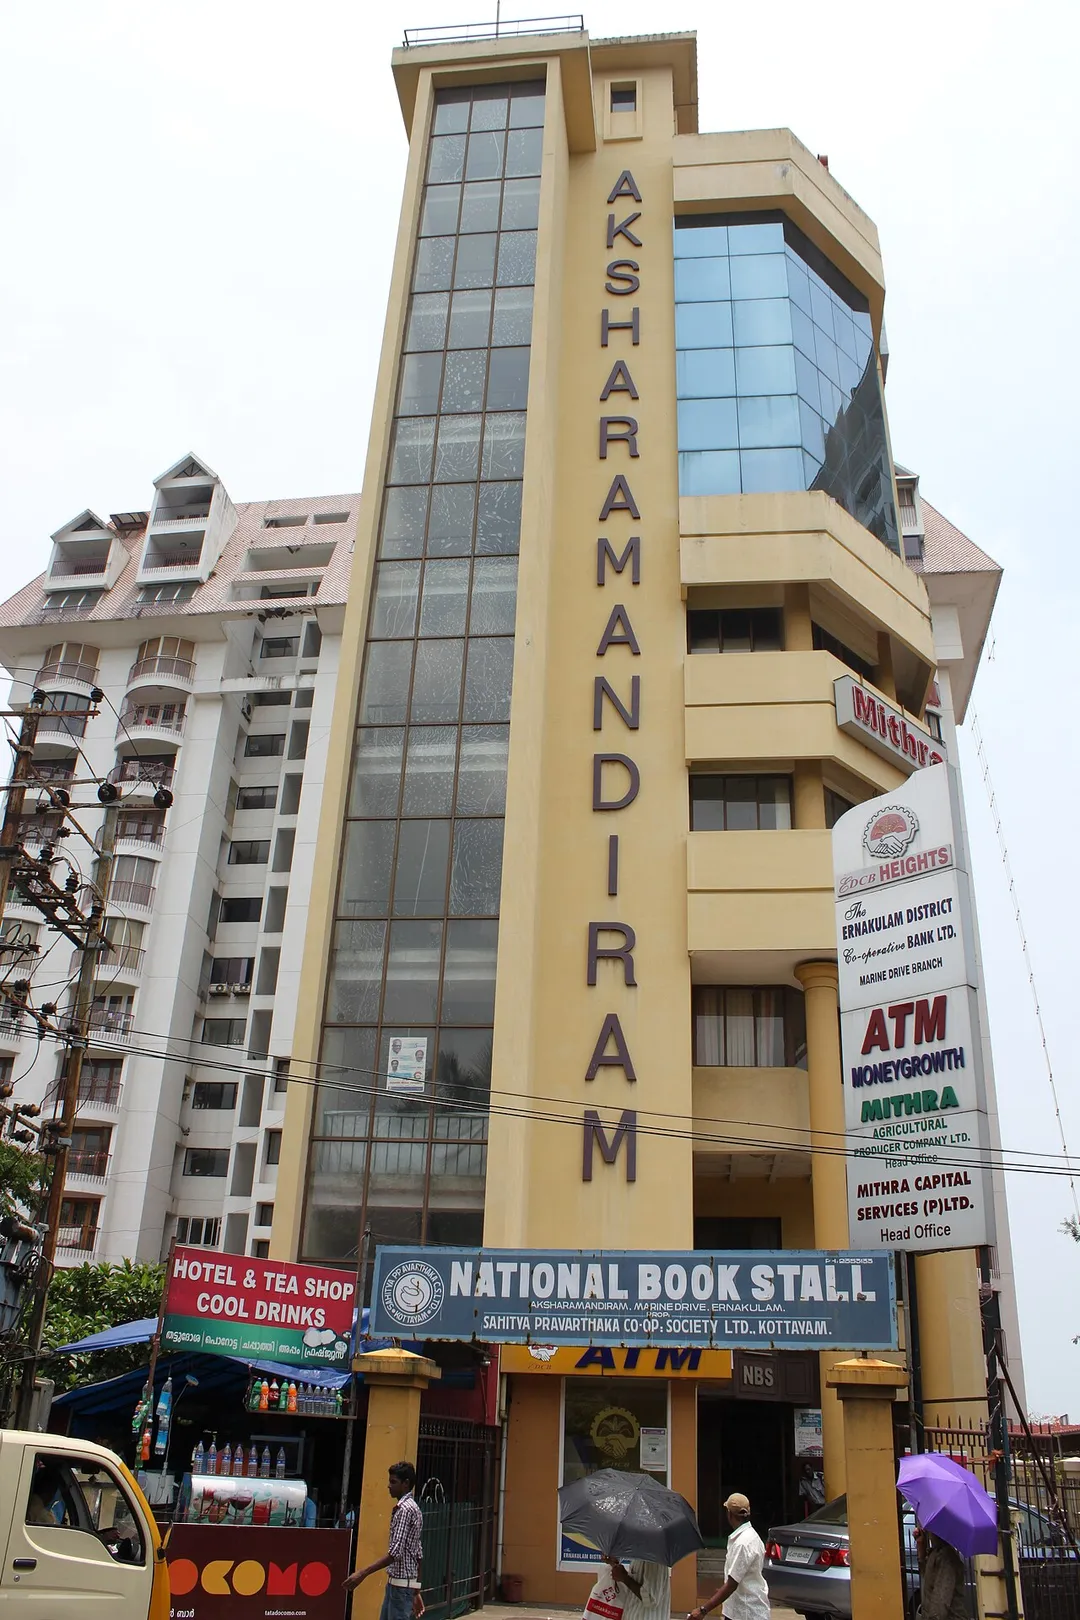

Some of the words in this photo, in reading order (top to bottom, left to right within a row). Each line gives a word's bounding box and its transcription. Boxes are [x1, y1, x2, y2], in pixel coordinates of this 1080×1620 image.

[582, 169, 643, 1182] AKSHARAMANDIRAM
[879, 847, 949, 882] HEIGHTS
[842, 911, 903, 940] ERNAKULAM
[906, 898, 953, 924] DISTRICT
[844, 901, 866, 921] The
[842, 942, 906, 965] Co-operative
[907, 931, 934, 950] BANK
[937, 924, 957, 943] LTD.
[859, 970, 887, 986] MARINE
[888, 965, 911, 980] DRIVE
[912, 957, 943, 974] BRANCH
[861, 994, 947, 1055] ATM
[851, 1047, 965, 1089] MONEYGROWTH
[861, 1086, 959, 1123] MITHRA
[872, 1117, 948, 1139] AGRICULTURAL
[853, 1142, 901, 1158] PRODUCER
[903, 1135, 947, 1150] COMPANY
[950, 1132, 971, 1144] LTD.
[885, 1155, 909, 1169] Head
[911, 1152, 938, 1166] Office
[857, 1178, 910, 1199] MITHRA
[914, 1171, 971, 1191] CAPITAL
[857, 1201, 919, 1221] SERVICES
[880, 1225, 911, 1242] Head
[914, 1224, 951, 1239] Office
[173, 1259, 237, 1286] HOTEL
[242, 1269, 256, 1289] &
[264, 1272, 298, 1294] TEA
[305, 1277, 354, 1301] SHOP
[449, 1261, 629, 1299] NATIONAL
[638, 1264, 741, 1301] BOOK
[750, 1264, 877, 1302] STALL
[197, 1293, 249, 1317] COOL
[255, 1301, 326, 1328] DRINKS
[394, 1310, 429, 1324] KOTTAYAM
[633, 1303, 673, 1311] MARINE
[483, 1316, 531, 1330] SAHITYA
[535, 1317, 620, 1332] PRAVARTHAKA
[666, 1319, 718, 1334] SOCIETY
[759, 1320, 832, 1335] KOTTAYAM.
[743, 1365, 774, 1386] NBS
